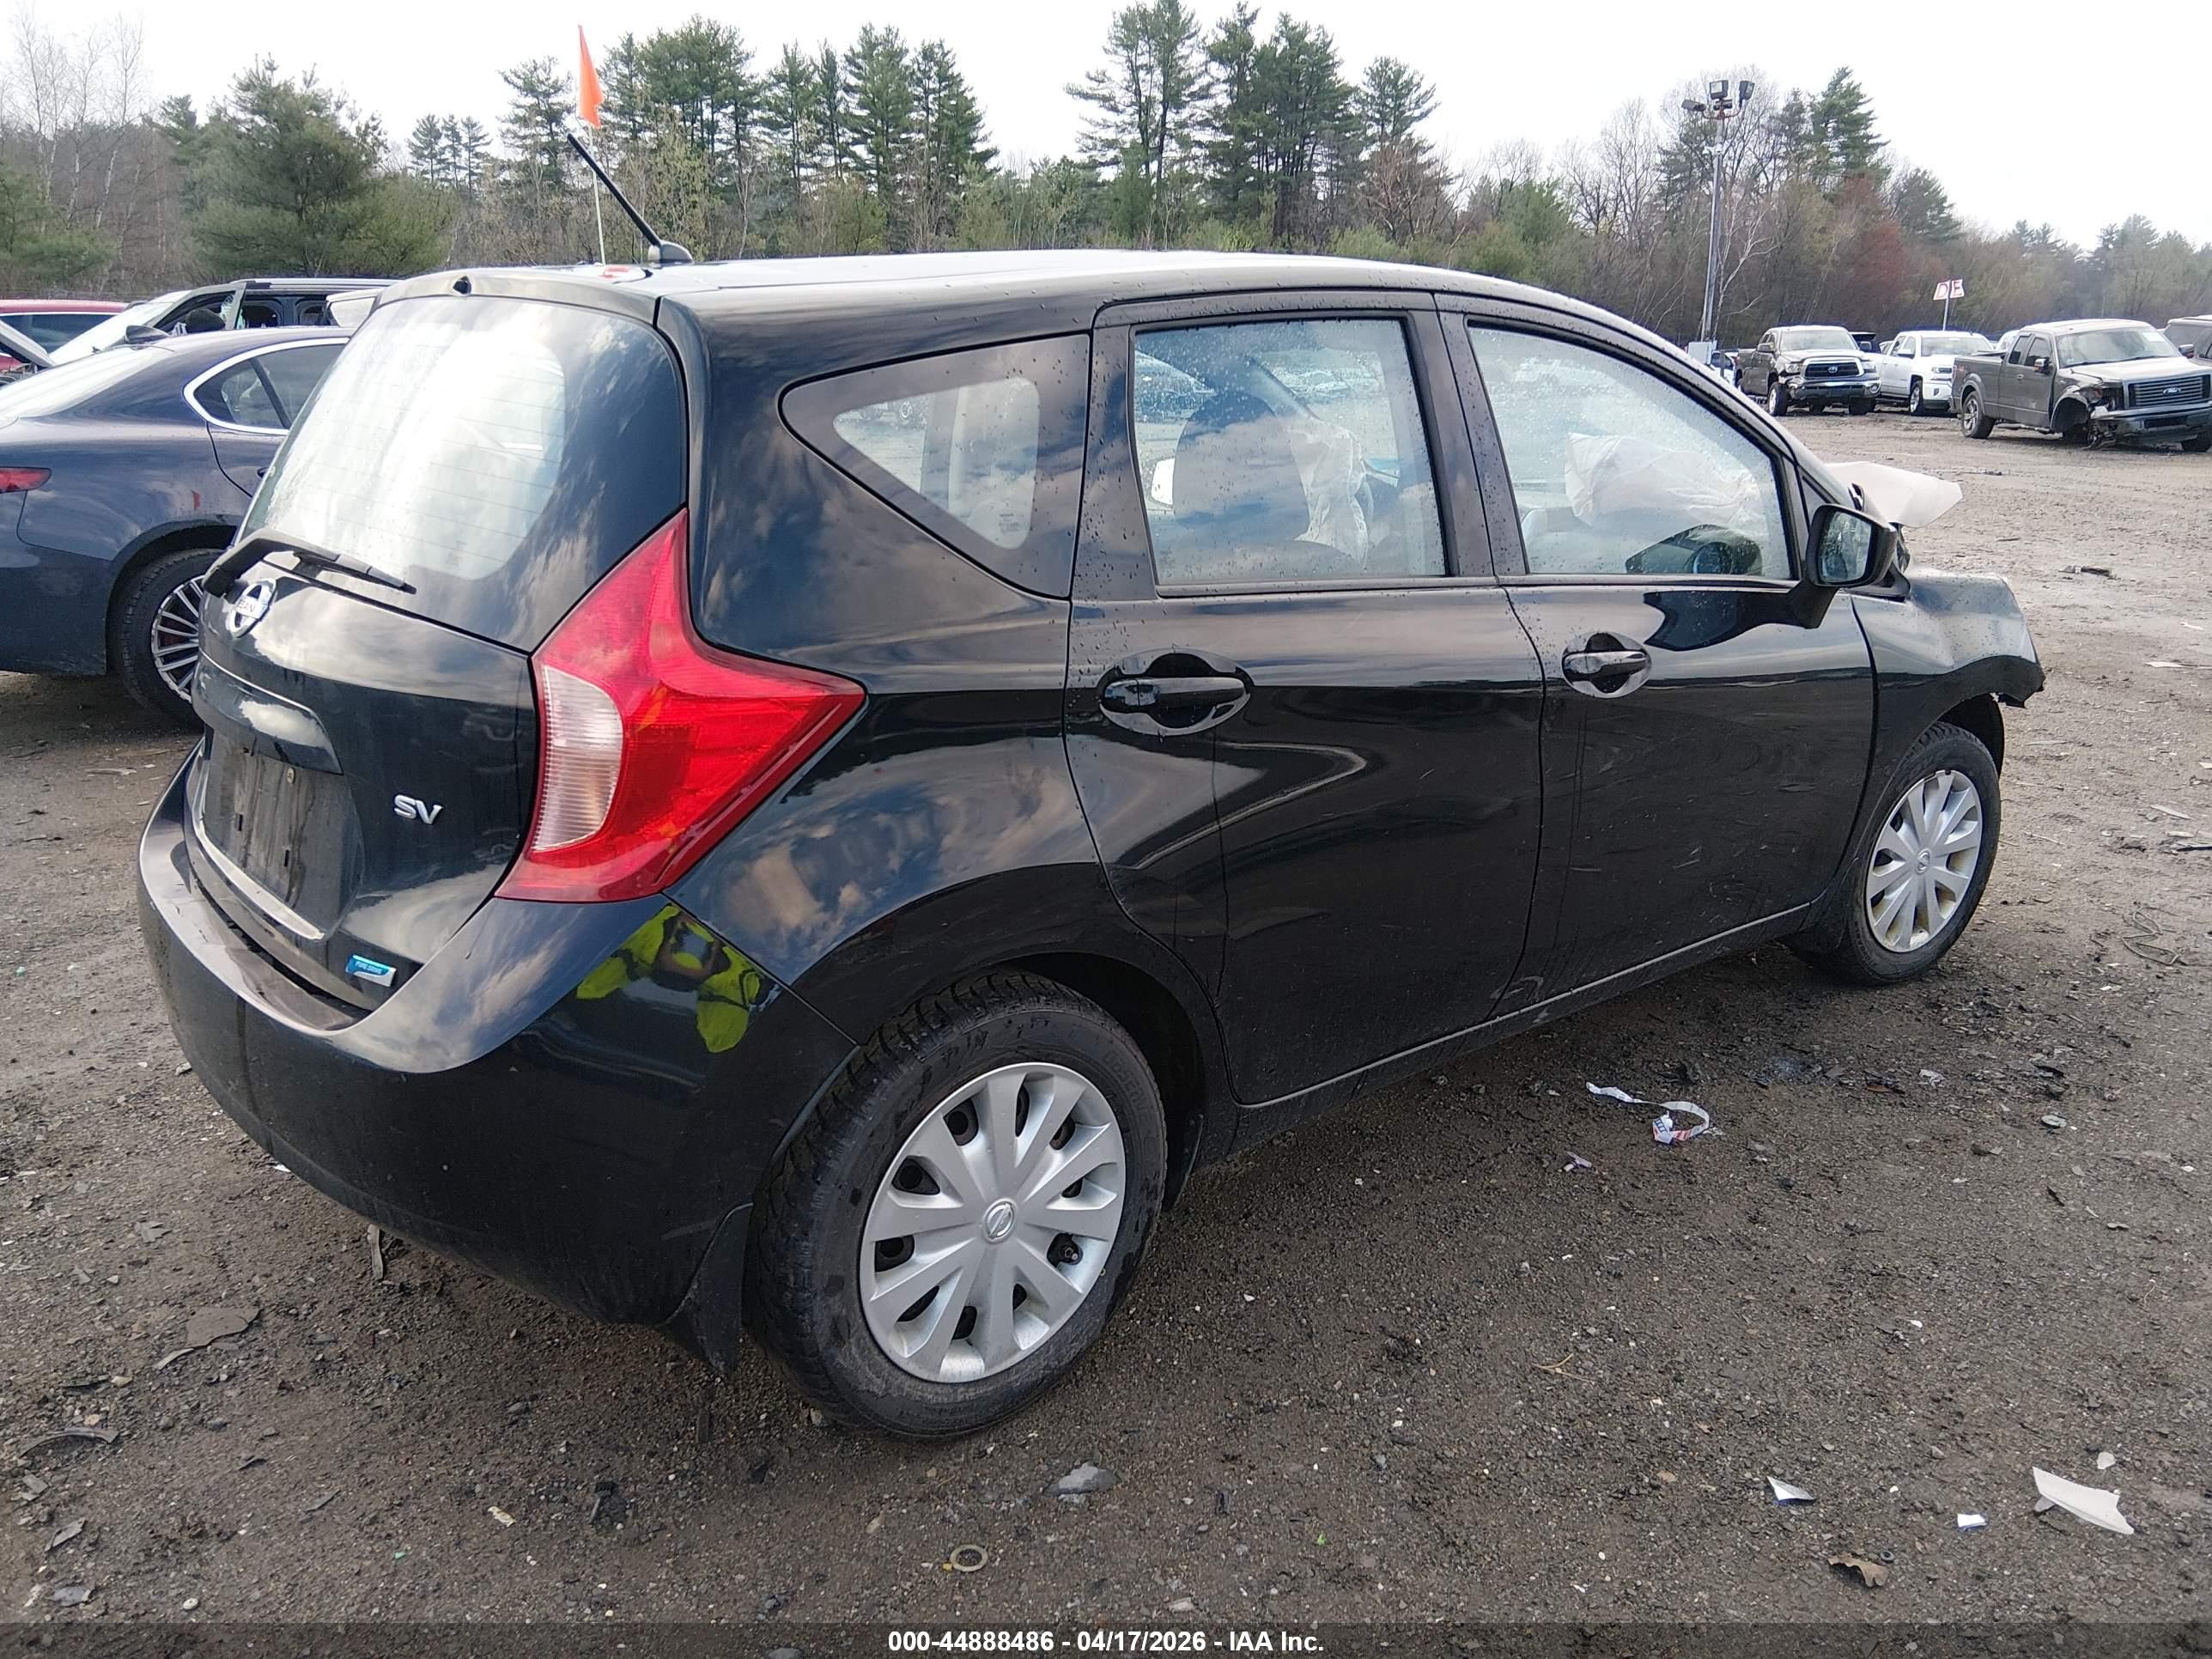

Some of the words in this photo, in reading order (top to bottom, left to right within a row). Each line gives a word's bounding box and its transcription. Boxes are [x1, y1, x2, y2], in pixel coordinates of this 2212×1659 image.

[1936, 283, 1948, 298] D
[1953, 281, 1963, 296] E
[393, 794, 443, 825] SV
